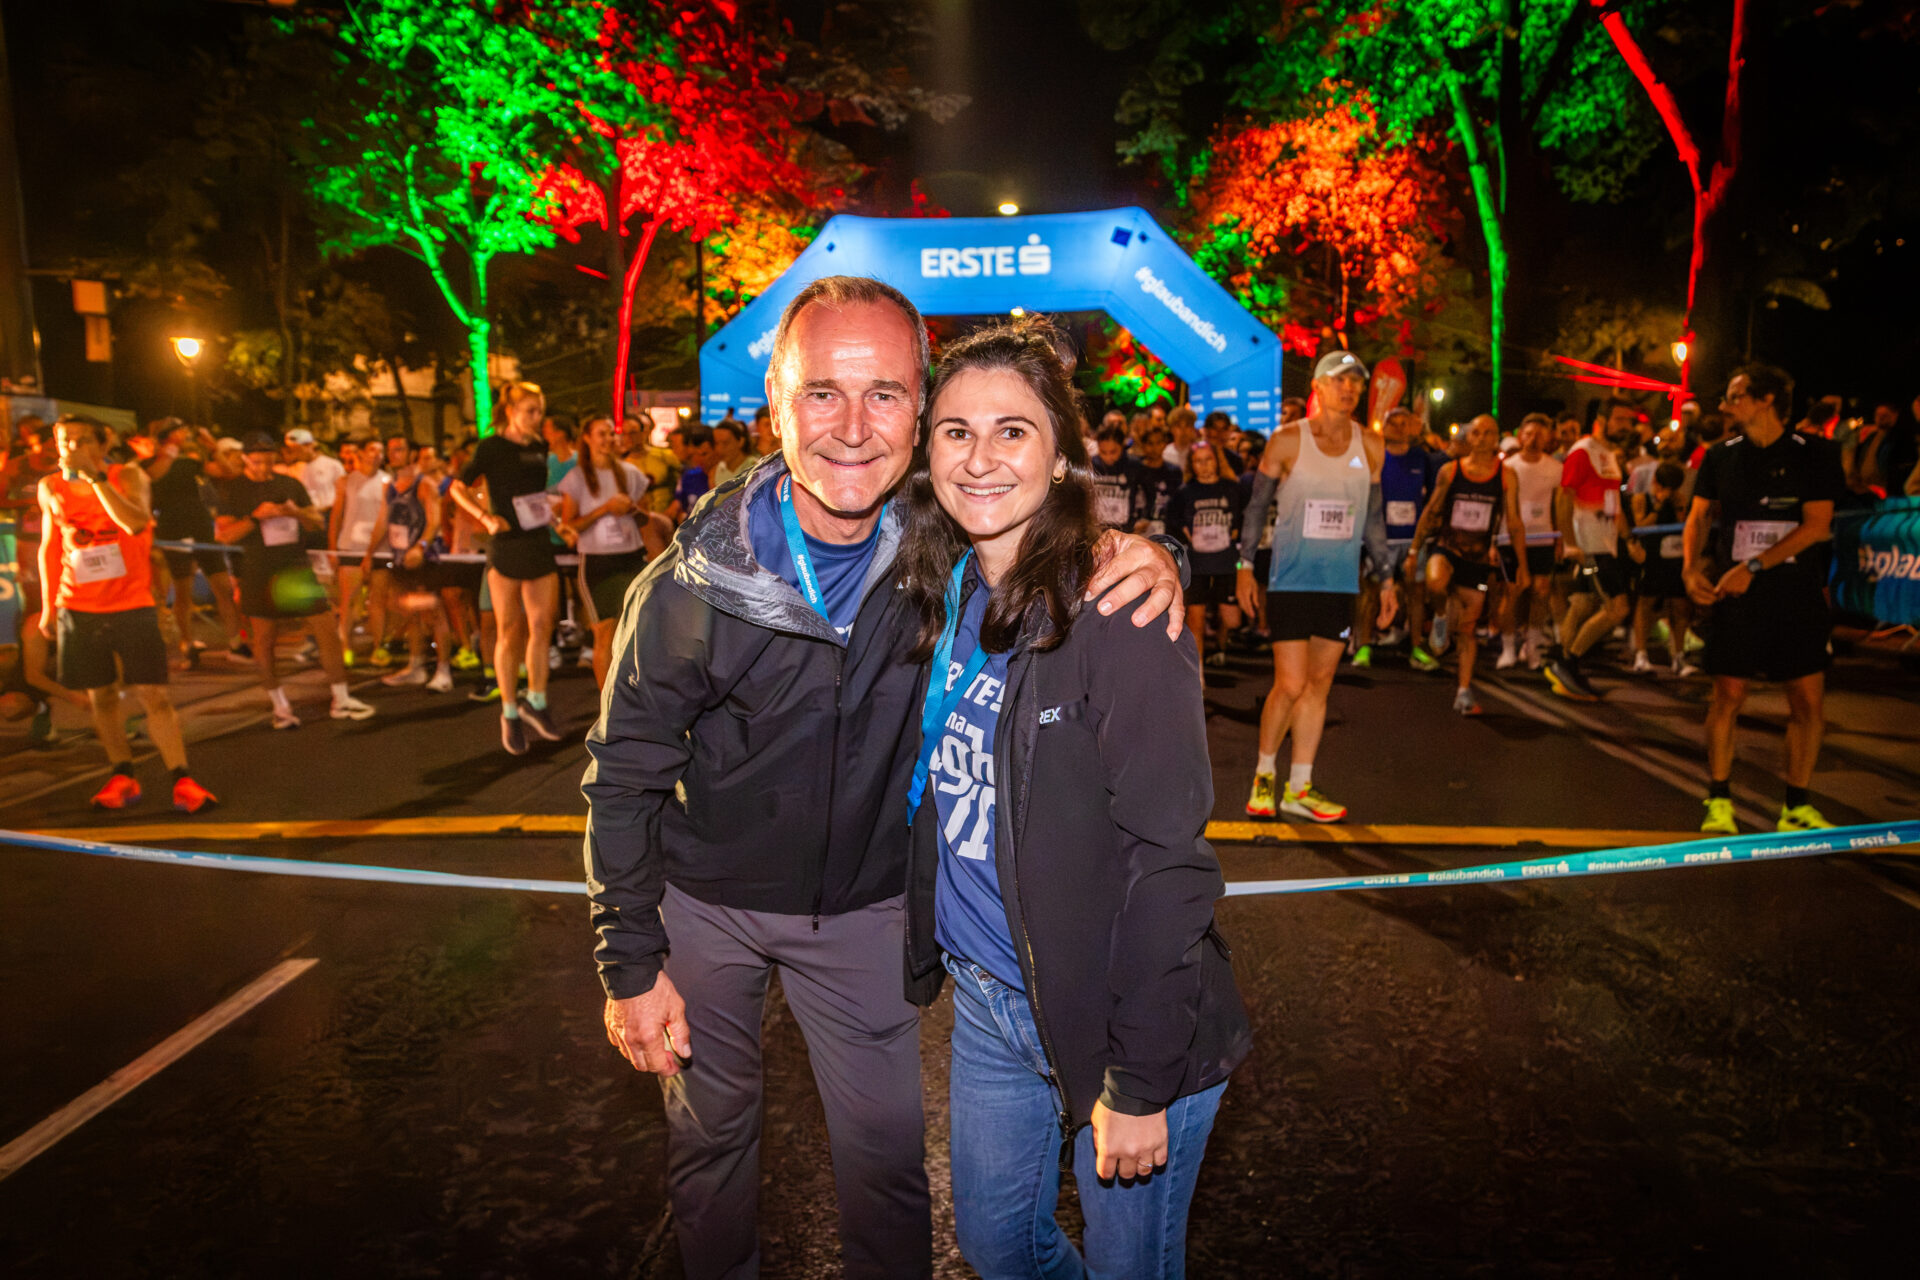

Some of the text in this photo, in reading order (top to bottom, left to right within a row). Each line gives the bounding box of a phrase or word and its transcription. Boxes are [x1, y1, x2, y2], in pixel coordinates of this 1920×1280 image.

[920, 247, 1016, 278] ERSTE
[1134, 266, 1227, 353] #glaubandich
[797, 554, 818, 604] #glaubandich
[1428, 867, 1505, 882] #glaubandich
[1521, 864, 1557, 878] ERSTE
